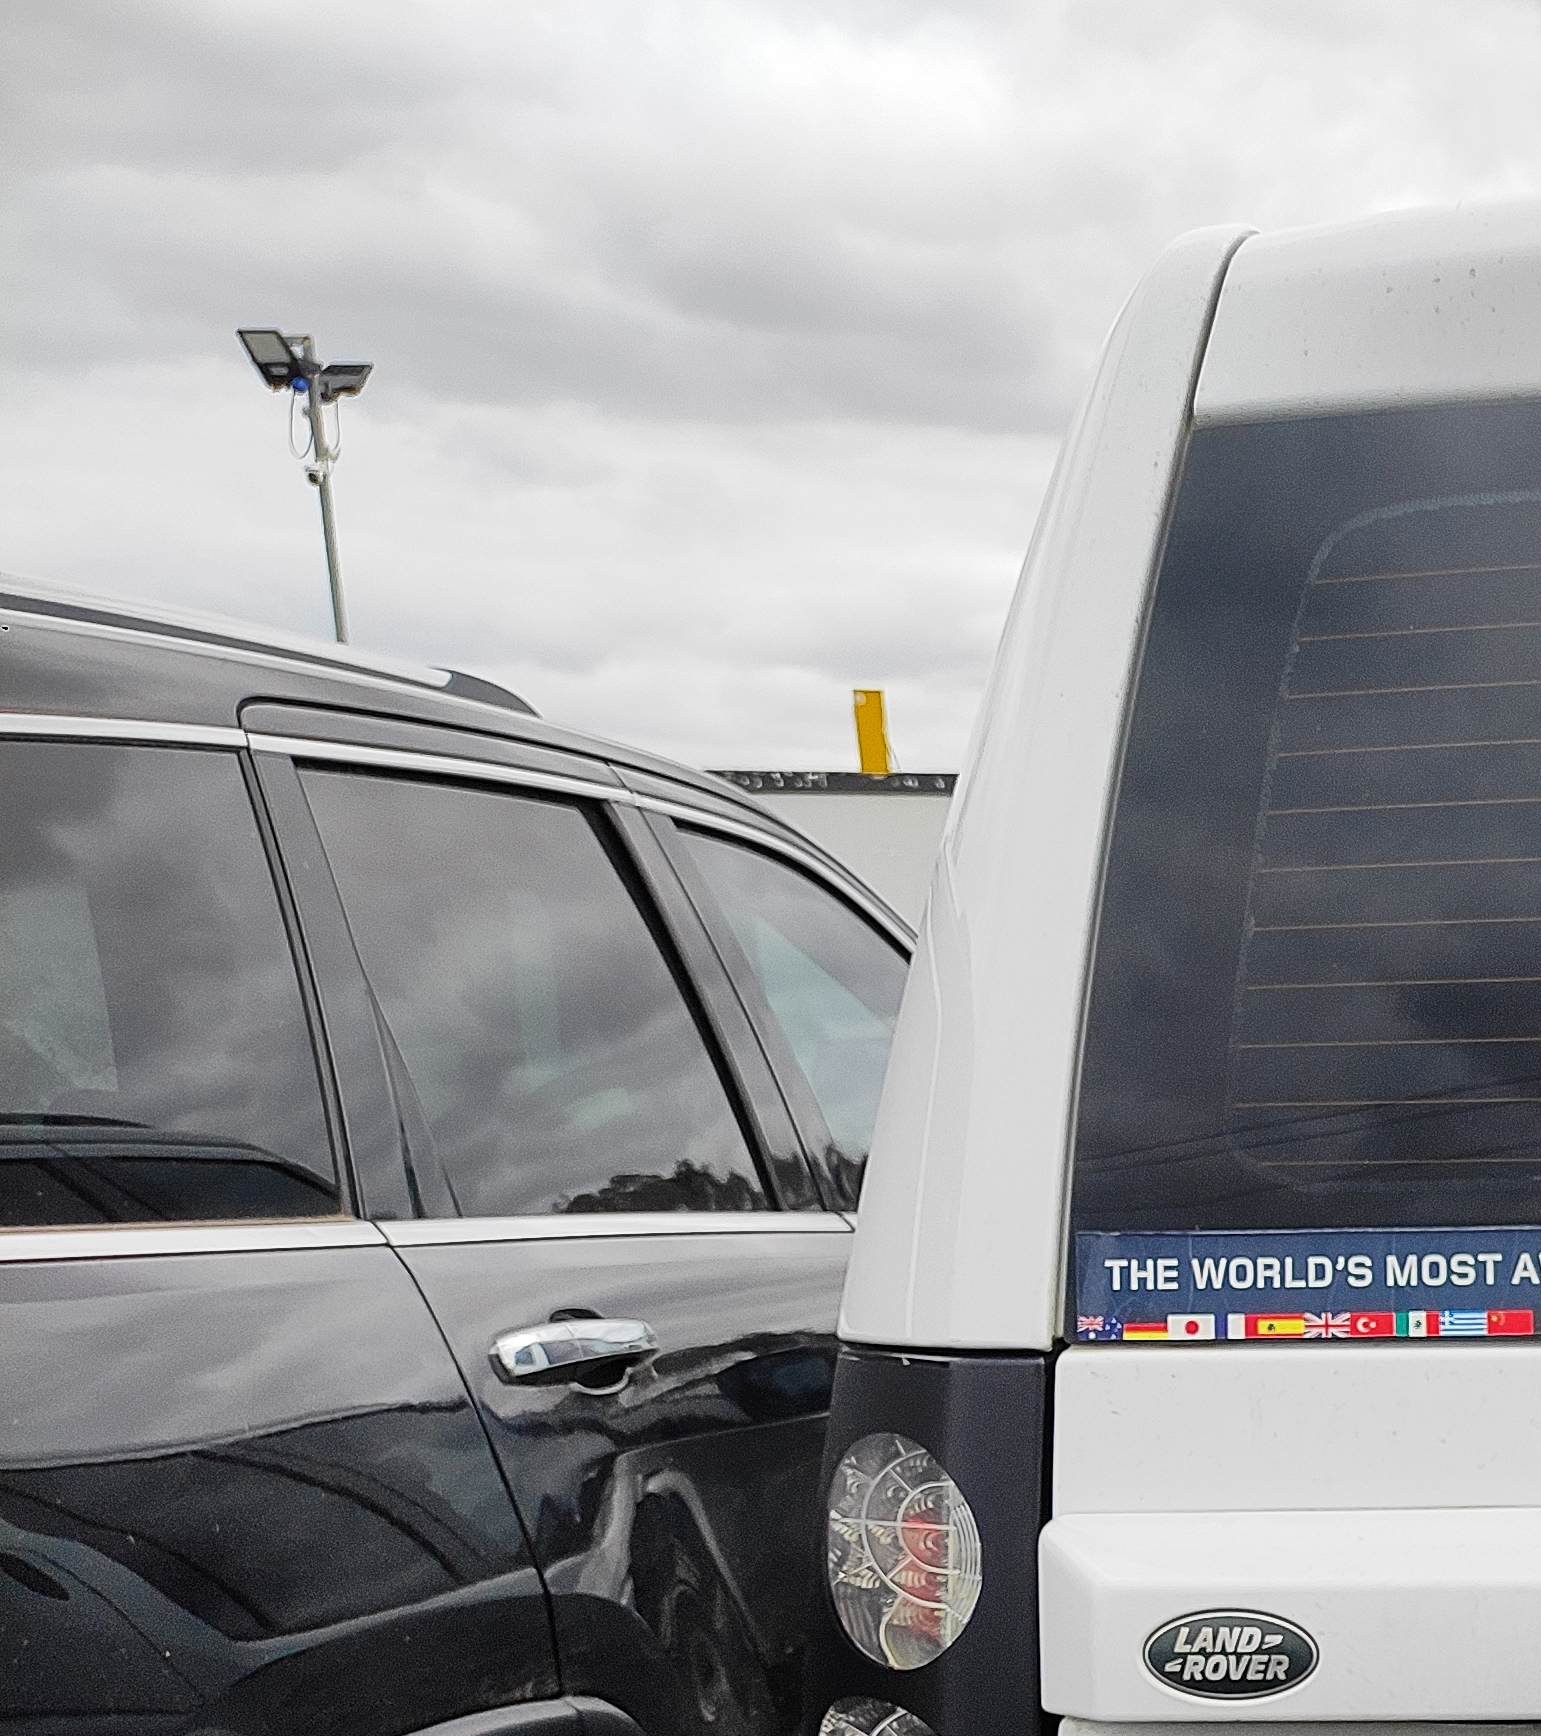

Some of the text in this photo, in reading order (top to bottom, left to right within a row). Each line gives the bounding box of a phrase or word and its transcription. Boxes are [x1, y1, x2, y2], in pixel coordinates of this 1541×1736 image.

[1103, 1258, 1180, 1291] THE
[1192, 1255, 1371, 1289] WORLD'S
[1385, 1254, 1503, 1287] MOST
[1173, 1626, 1262, 1653] LAND
[1182, 1654, 1290, 1681] ROVER
